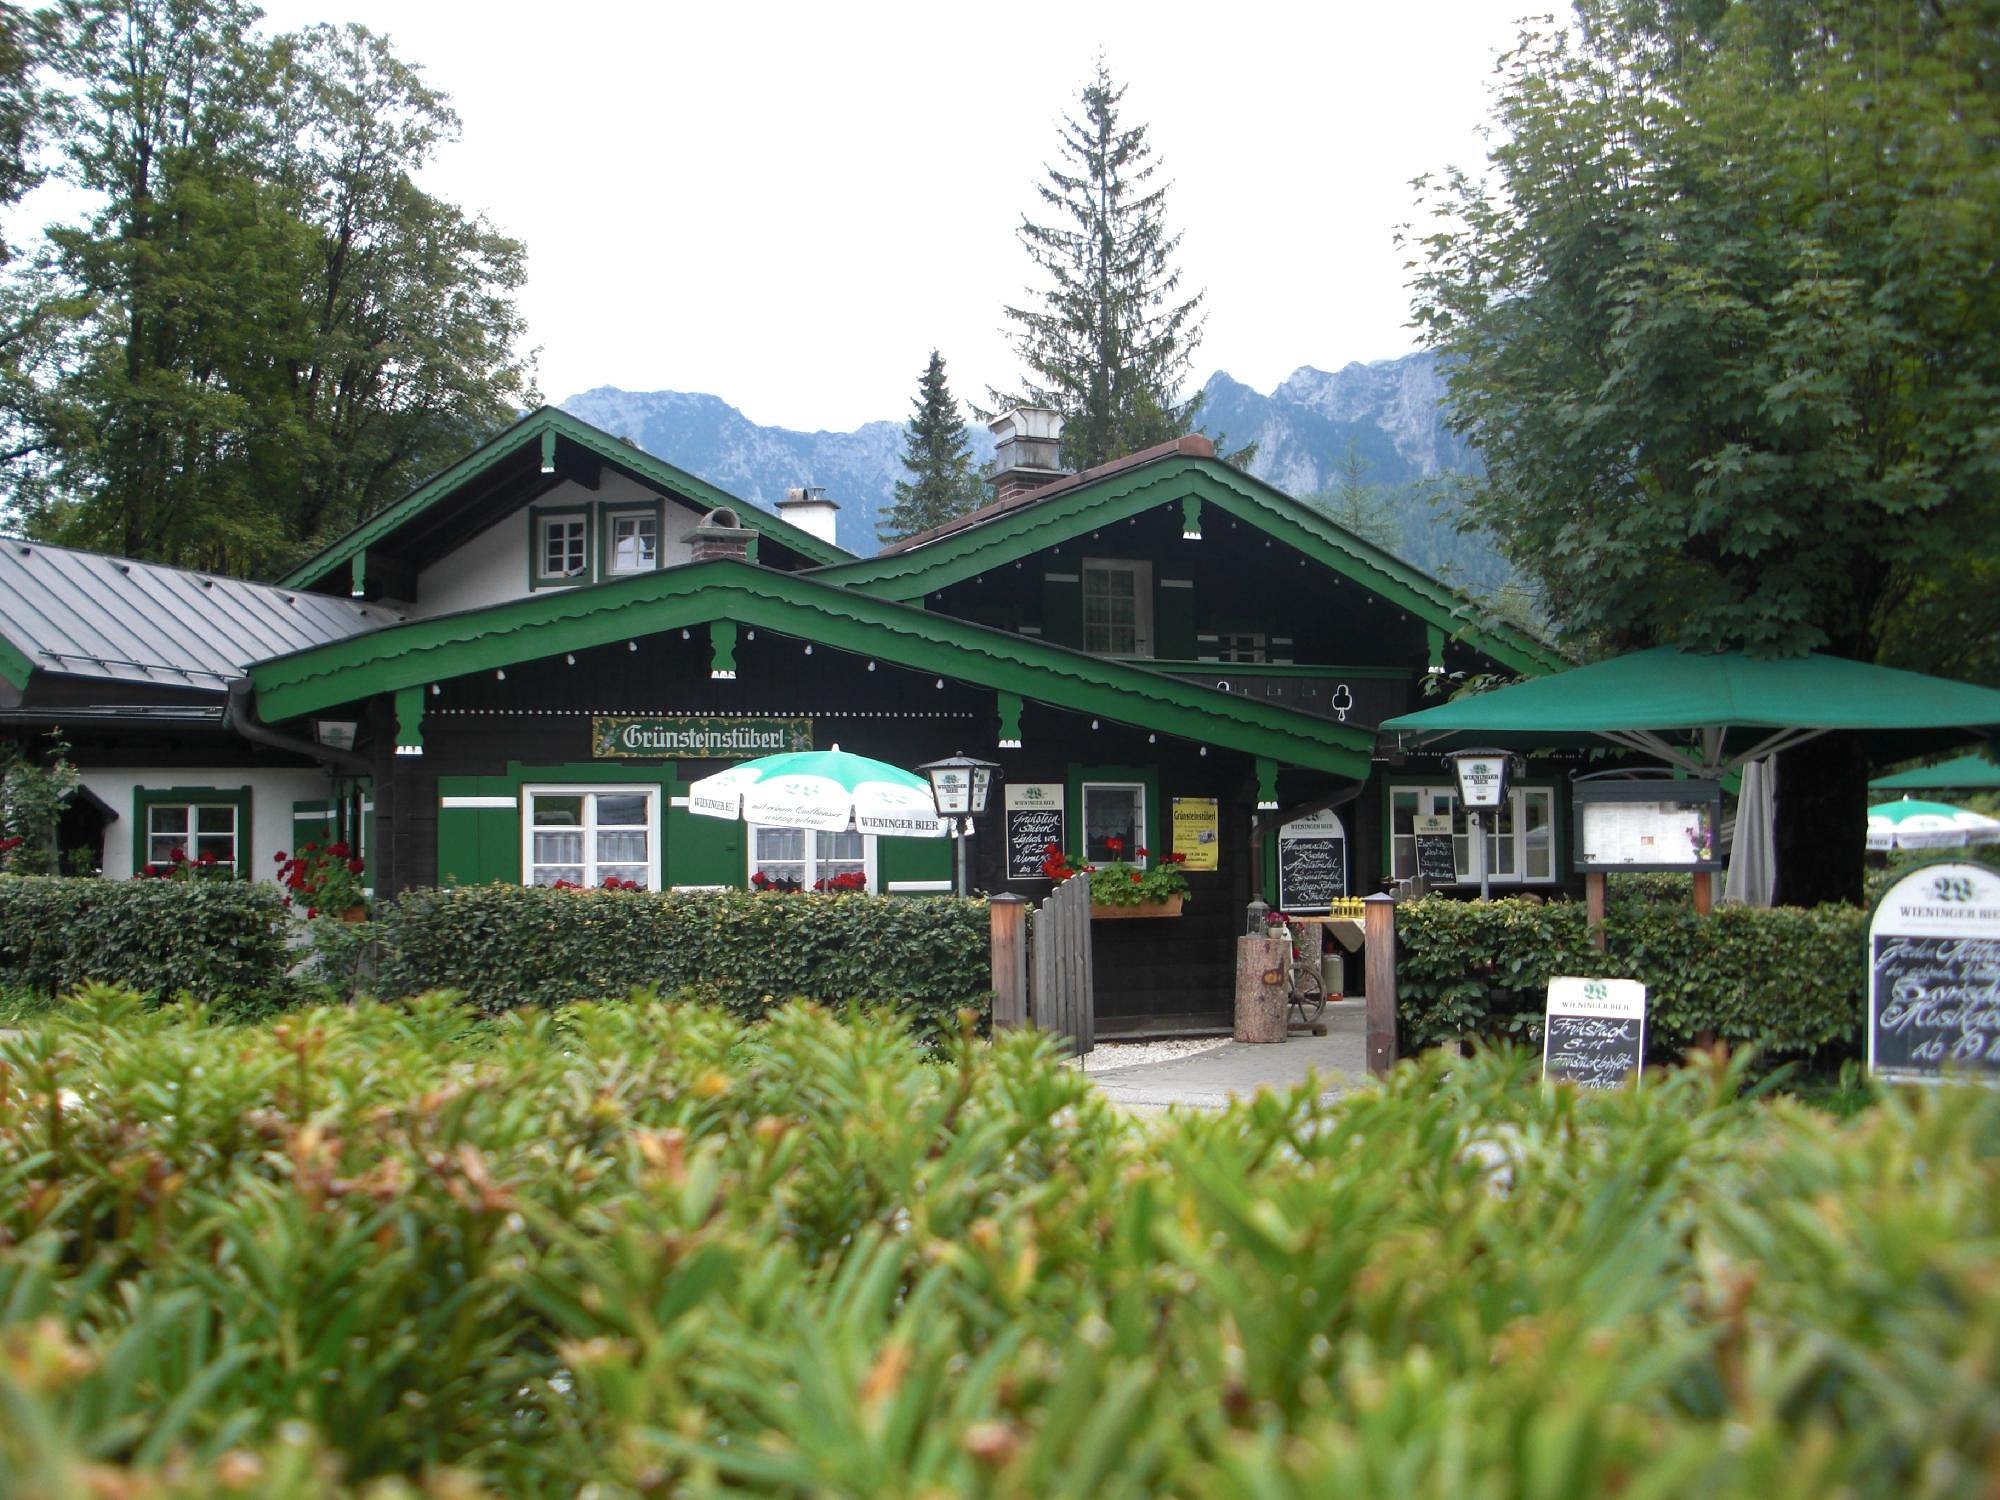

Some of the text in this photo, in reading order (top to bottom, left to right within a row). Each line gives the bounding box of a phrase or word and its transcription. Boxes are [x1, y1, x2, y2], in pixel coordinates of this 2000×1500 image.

[623, 725, 785, 748] Grünsteinstüberl
[861, 817, 939, 831] WIENINGER BIER
[1901, 906, 2000, 918] WIENINGER BIE
